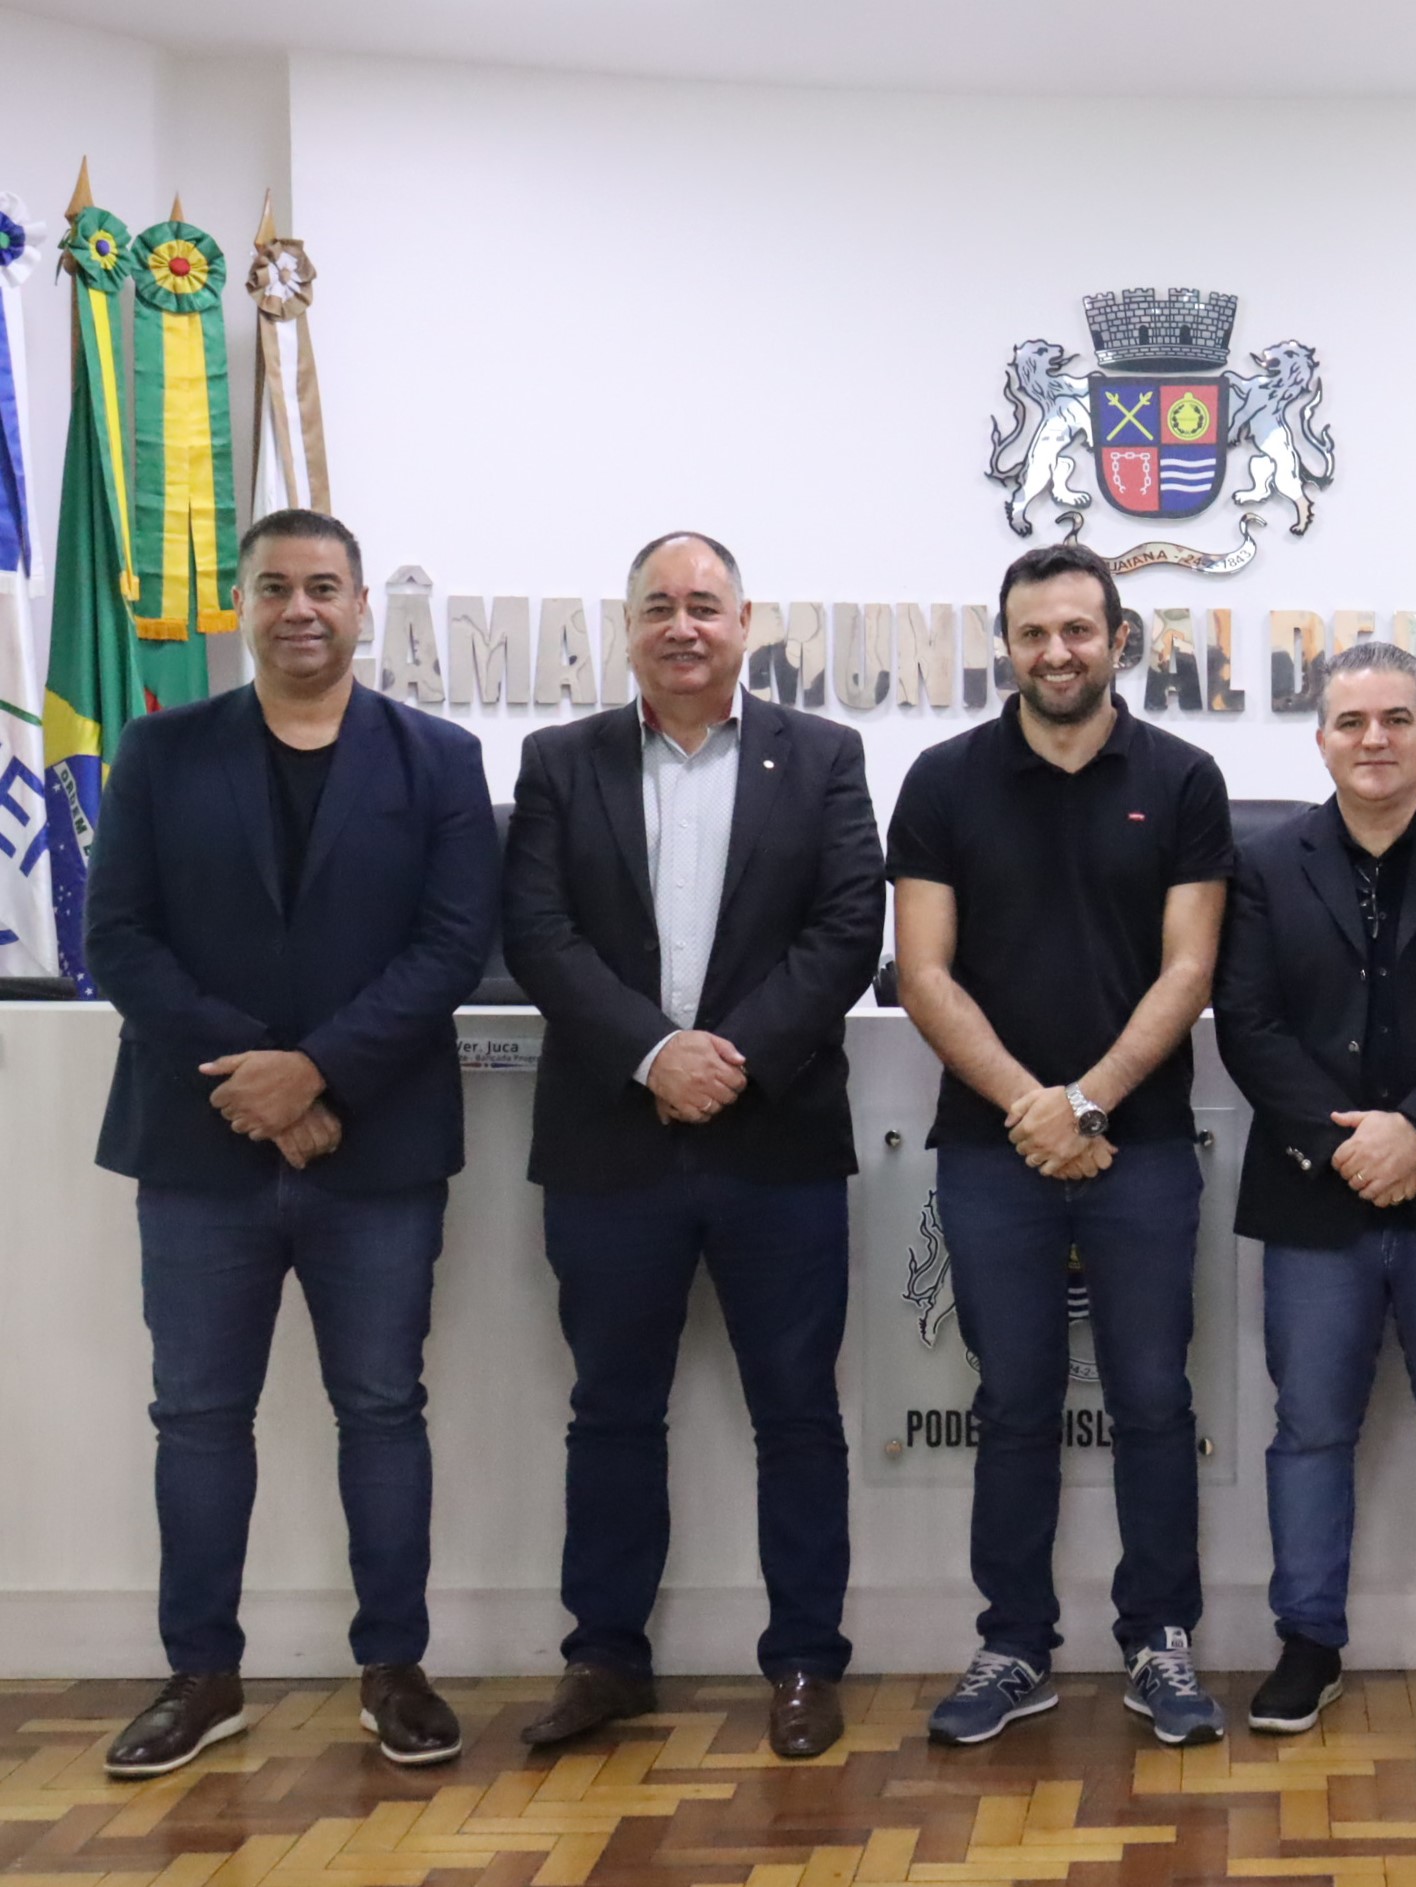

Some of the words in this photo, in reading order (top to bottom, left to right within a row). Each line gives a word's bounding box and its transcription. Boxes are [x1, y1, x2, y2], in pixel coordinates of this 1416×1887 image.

[1106, 550, 1168, 572] UAIANA
[352, 565, 629, 703] ÂMA
[748, 602, 1245, 711] MUNIAL
[486, 1041, 518, 1055] Juca
[907, 1410, 979, 1448] PODE
